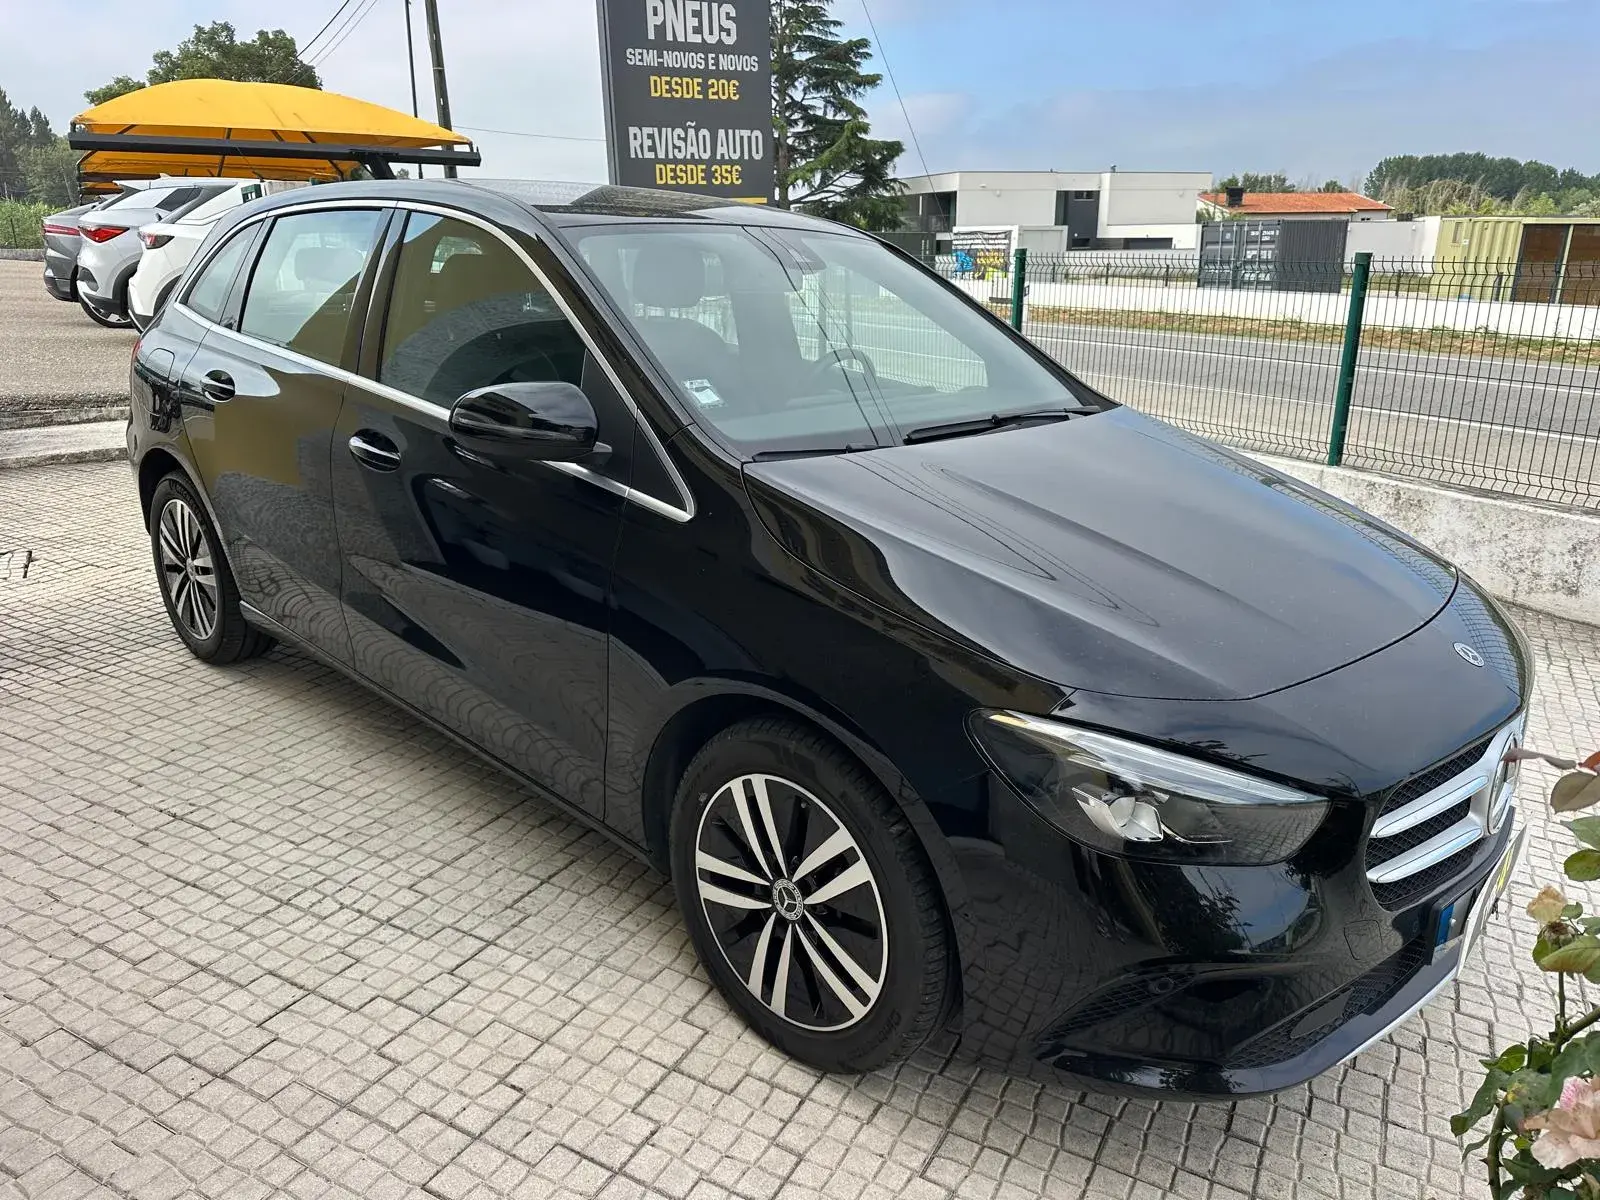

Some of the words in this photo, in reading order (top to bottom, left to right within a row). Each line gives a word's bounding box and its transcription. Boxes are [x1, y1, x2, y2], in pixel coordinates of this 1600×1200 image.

[645, 0, 737, 45] PNEUS
[626, 48, 705, 69] SEMI-NOVOS
[708, 54, 716, 69] E
[718, 55, 759, 72] NOVOS
[649, 75, 703, 99] DESDE
[707, 78, 740, 100] 20€
[628, 121, 711, 160] REVISÃO
[716, 128, 763, 160] AUTO
[655, 164, 707, 185] DESDE
[711, 165, 742, 185] 35€
